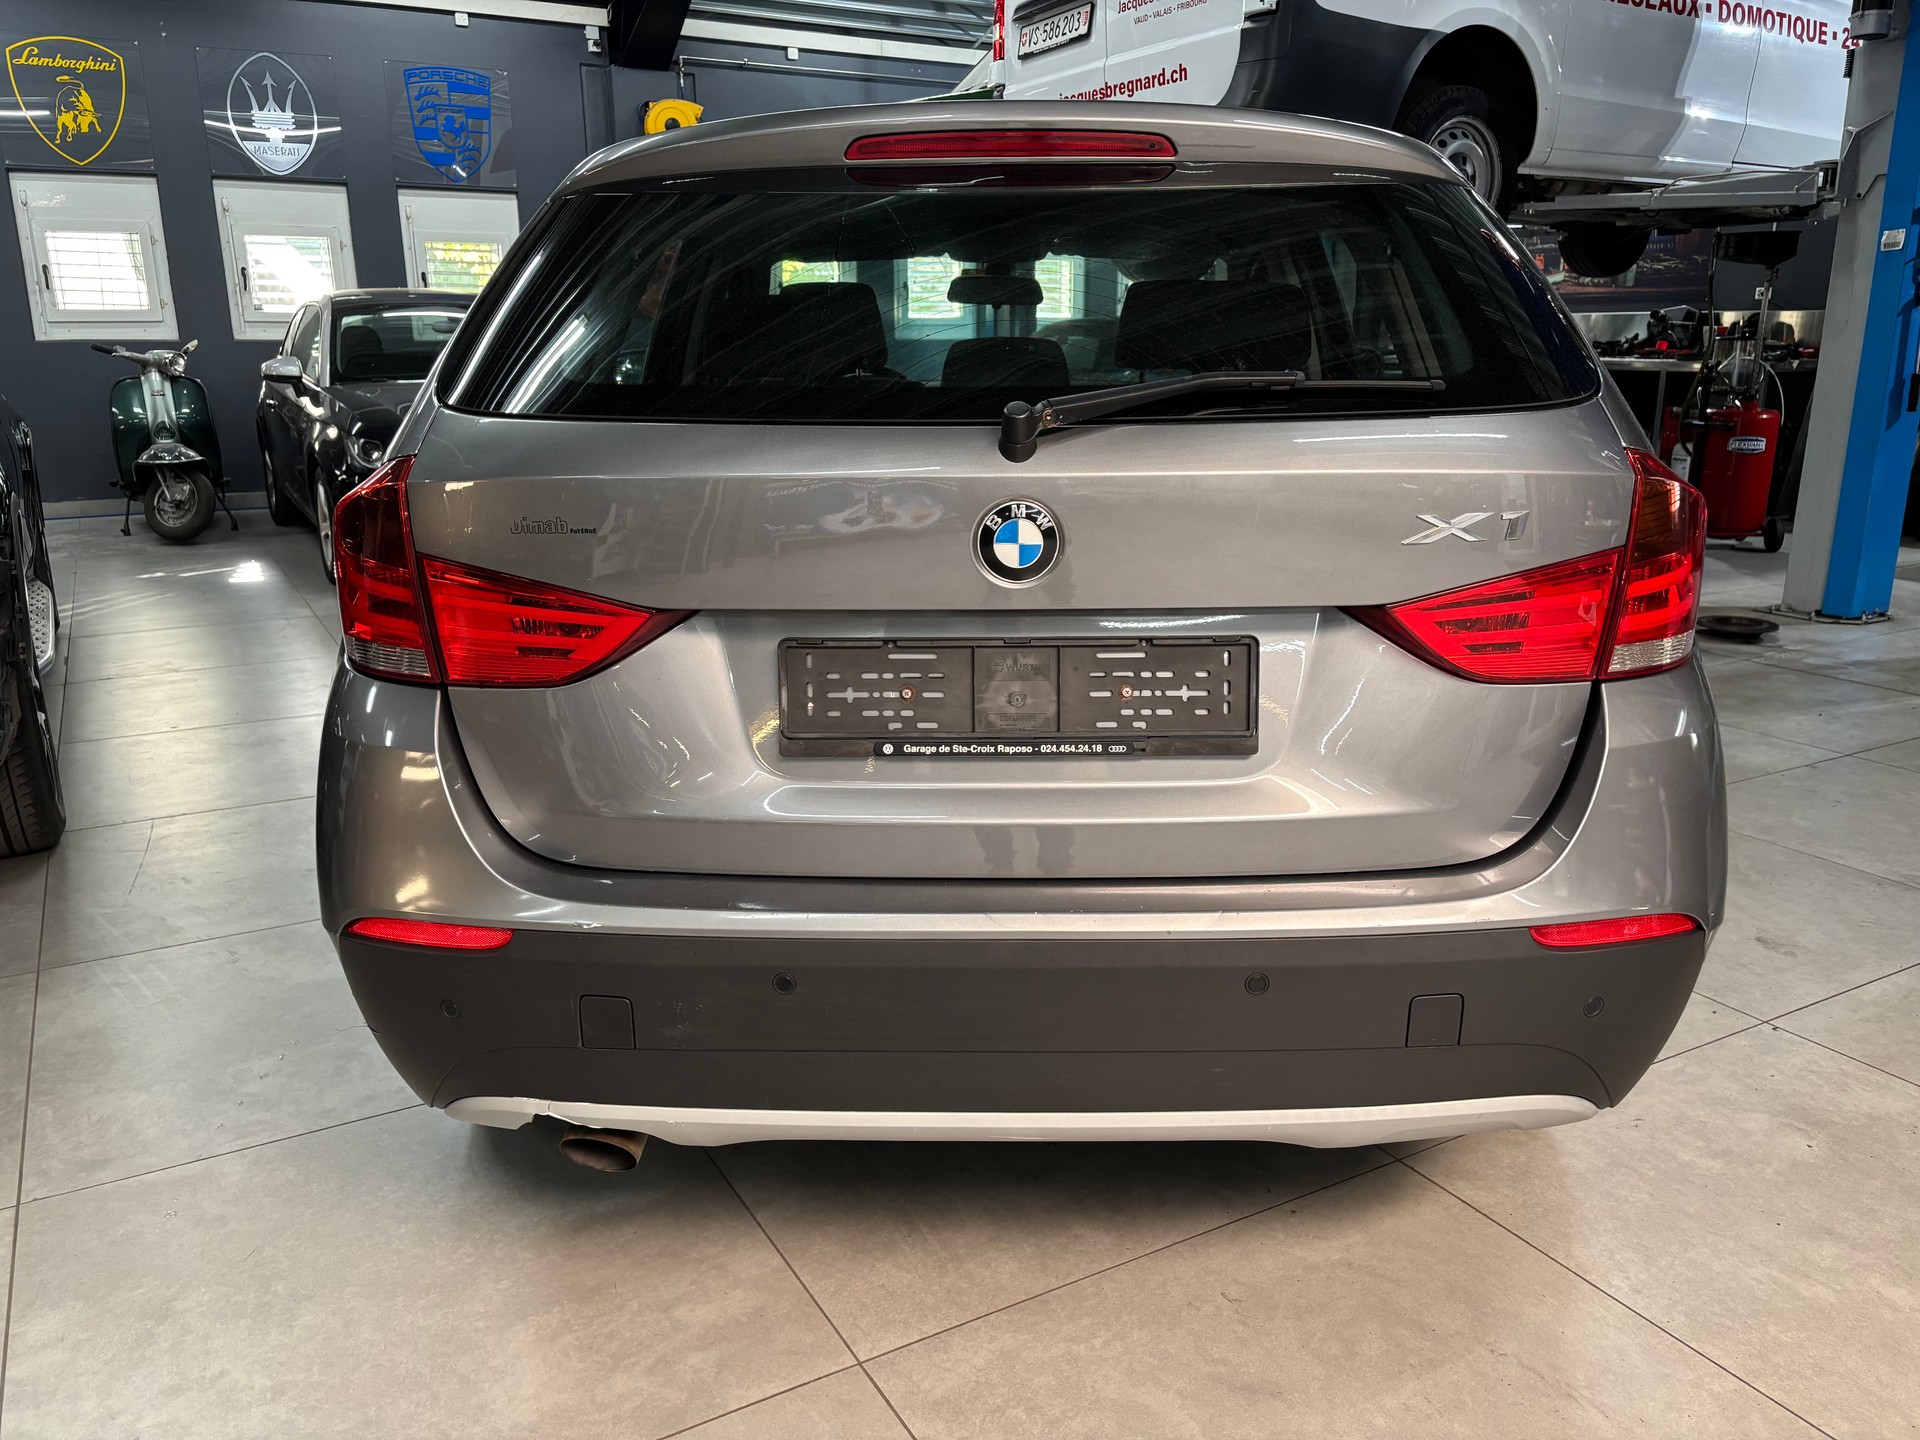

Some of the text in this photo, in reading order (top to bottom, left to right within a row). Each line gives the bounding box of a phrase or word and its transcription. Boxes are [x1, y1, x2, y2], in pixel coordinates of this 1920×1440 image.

[1118, 0, 1154, 14] Jacqu
[1134, 14, 1149, 24] VAUD
[1153, 7, 1173, 19] VALAIS
[1718, 0, 1828, 45] DOMOTIQUE
[12, 46, 117, 73] Lamborghini
[407, 70, 488, 88] PORSCHE
[1059, 63, 1188, 99] uesbregnard.ch
[253, 145, 300, 157] MASERATI
[985, 504, 1053, 531] BMW
[1401, 509, 1531, 545] X1
[903, 744, 937, 755] Garage
[938, 744, 950, 753] de
[952, 744, 995, 753] Ste-Croix
[997, 744, 1033, 755] Raposo
[1040, 744, 1103, 753] 024.454.24.18
